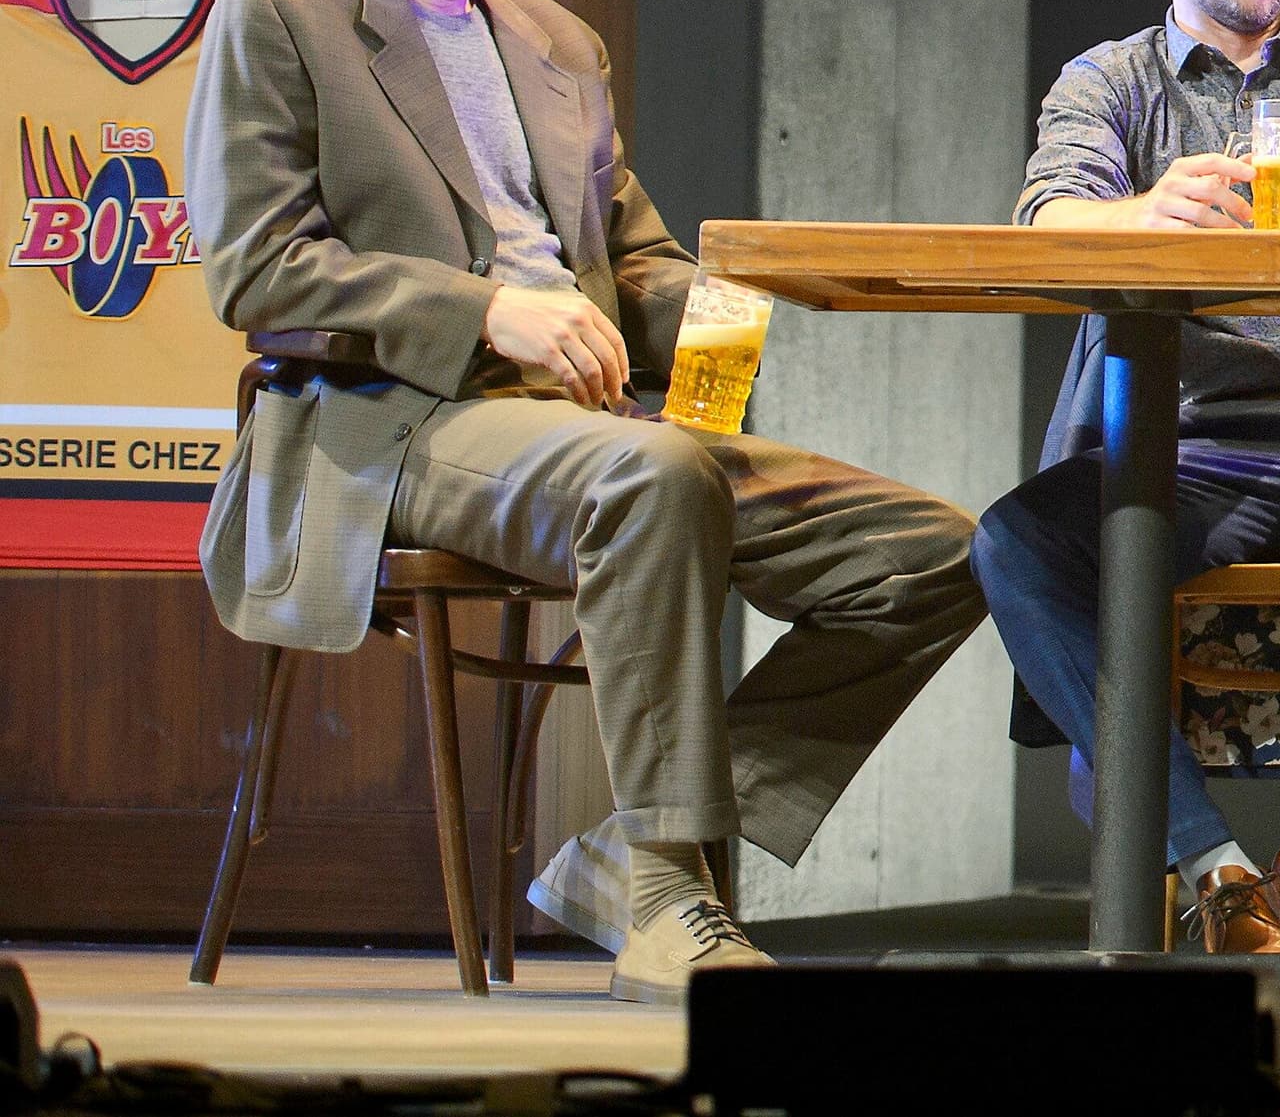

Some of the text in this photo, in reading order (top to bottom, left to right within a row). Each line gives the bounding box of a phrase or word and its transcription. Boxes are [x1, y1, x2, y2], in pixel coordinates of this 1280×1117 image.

[101, 123, 154, 153] Les
[10, 197, 201, 267] BOY
[0, 437, 221, 472] SSERIE CHEZ
